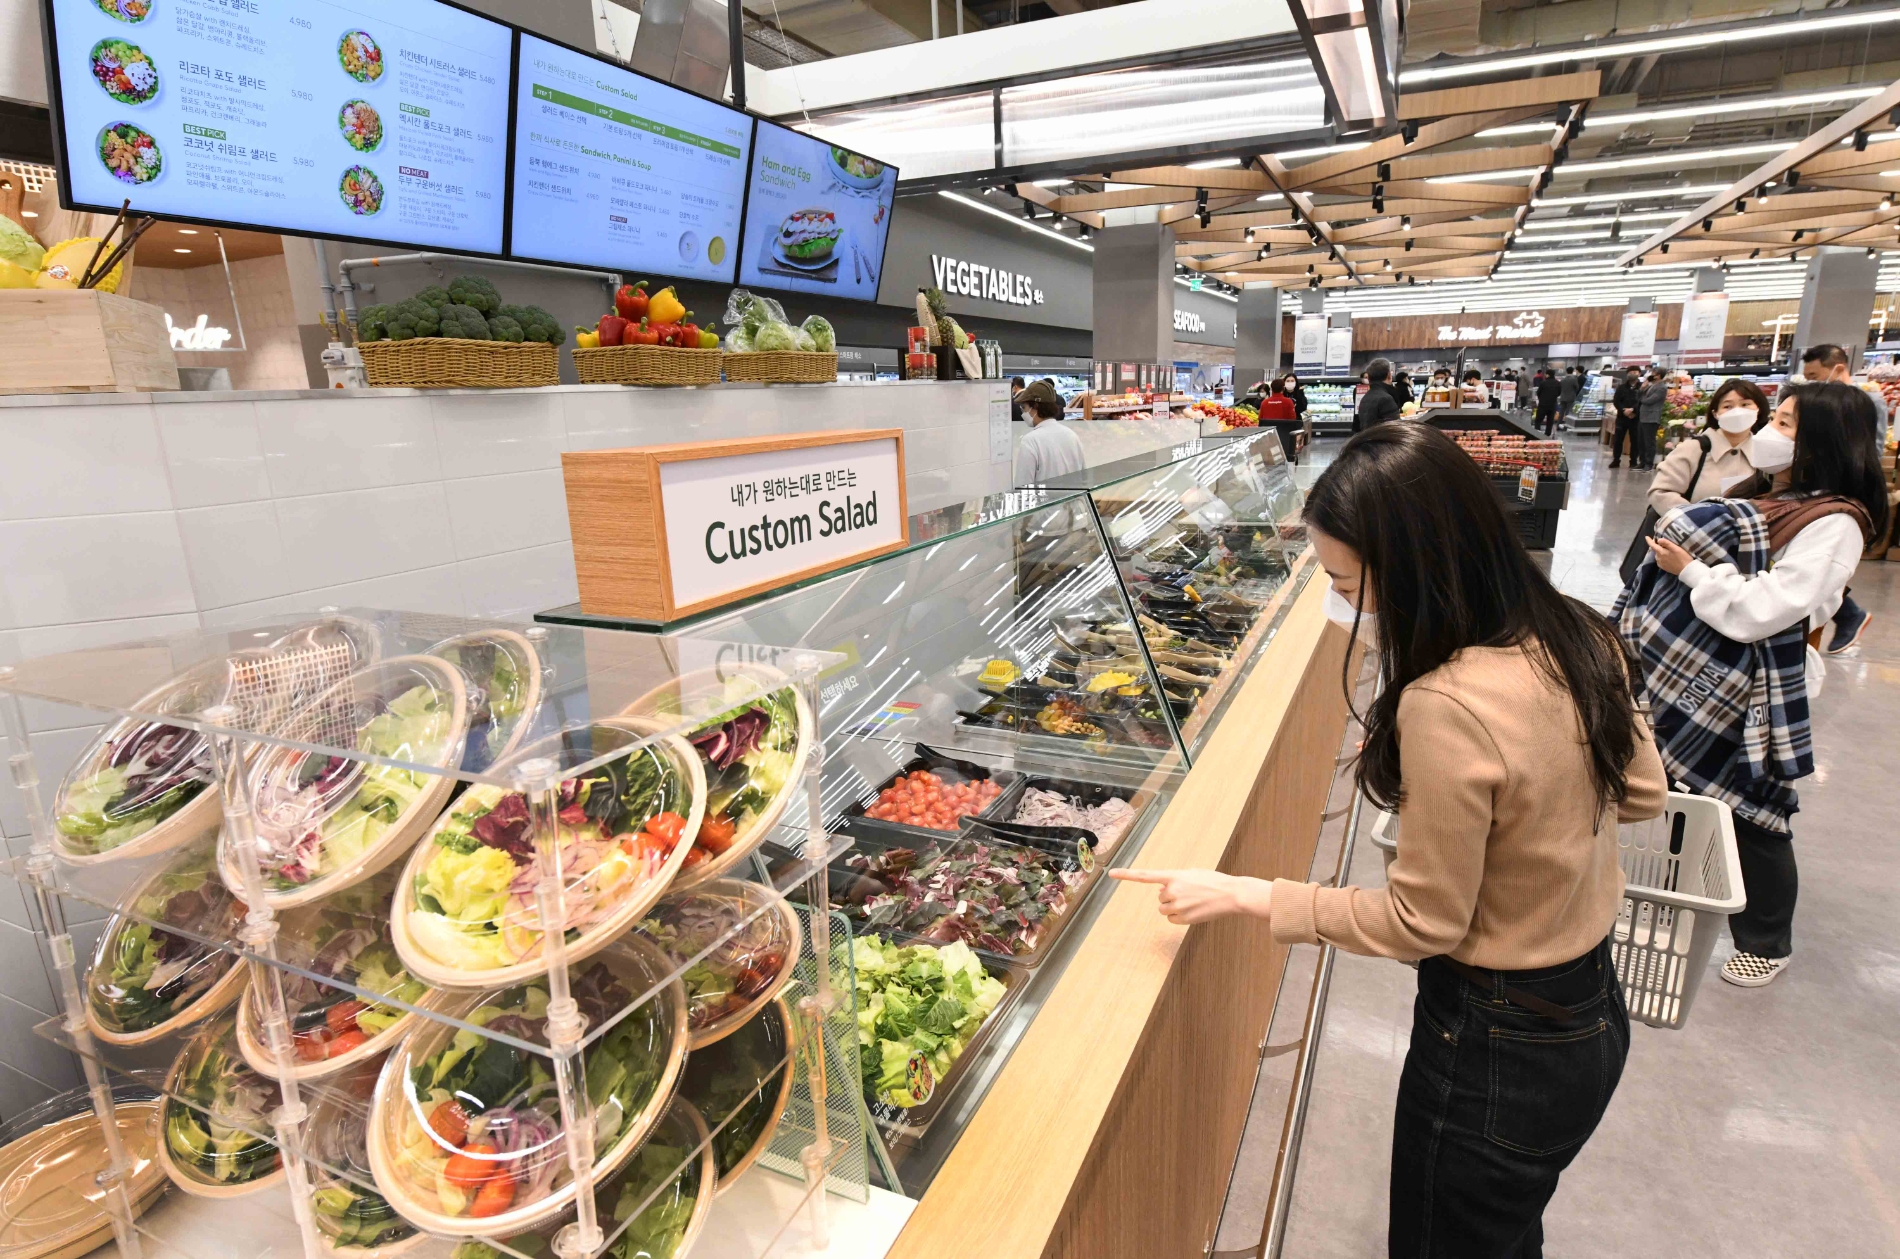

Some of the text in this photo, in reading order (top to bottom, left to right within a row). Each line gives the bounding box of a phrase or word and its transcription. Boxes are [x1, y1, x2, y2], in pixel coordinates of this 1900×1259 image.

[204, 16, 218, 24] with
[221, 8, 238, 18] Salad
[399, 48, 428, 66] 치킨텐더
[430, 58, 456, 74] 시트러스
[458, 66, 478, 80] 샐러드
[179, 60, 210, 78] 리코타
[214, 68, 234, 83] 포도
[238, 74, 267, 91] 샐러드
[180, 74, 242, 94] Ricotta Grape Salad
[534, 58, 638, 101] 내가 원하는대로 만드는 Custom Salad
[214, 94, 228, 102] with
[536, 88, 552, 100] STEP 1
[400, 103, 415, 112] BEST
[541, 104, 587, 125] 샐러드 베이스 선택
[608, 110, 613, 118] 2
[185, 124, 226, 140] BEST PICK
[399, 114, 421, 128] 멕시칸
[424, 119, 450, 134] 풀드포크
[452, 126, 473, 140] 샐러드
[184, 136, 214, 152] 코코넛
[218, 143, 247, 157] 쉬림프
[250, 148, 278, 162] 샐러드
[185, 150, 210, 160] Coconut
[212, 154, 233, 164] Shrimp
[544, 136, 561, 147] 식사로
[580, 146, 612, 161] Sandwich,
[612, 154, 632, 167] Panini
[632, 158, 636, 166] &
[638, 161, 652, 172] Soup
[401, 166, 428, 178] NO MEAT
[760, 170, 796, 190] Sandwich
[762, 156, 811, 183] Ham and Egg
[398, 175, 412, 186] 두부
[414, 178, 442, 192] 구운버섯
[444, 184, 464, 196] 샐러드
[551, 184, 572, 196] 샌드위치
[932, 254, 1032, 306] VEGETABLES
[1174, 309, 1200, 332] SEAFOOD
[1438, 324, 1544, 340] The Meat Market
[730, 468, 857, 508] 내가 원하는대로 만드는
[704, 490, 878, 564] Custom Salad
[820, 675, 860, 704] 선택하세요
